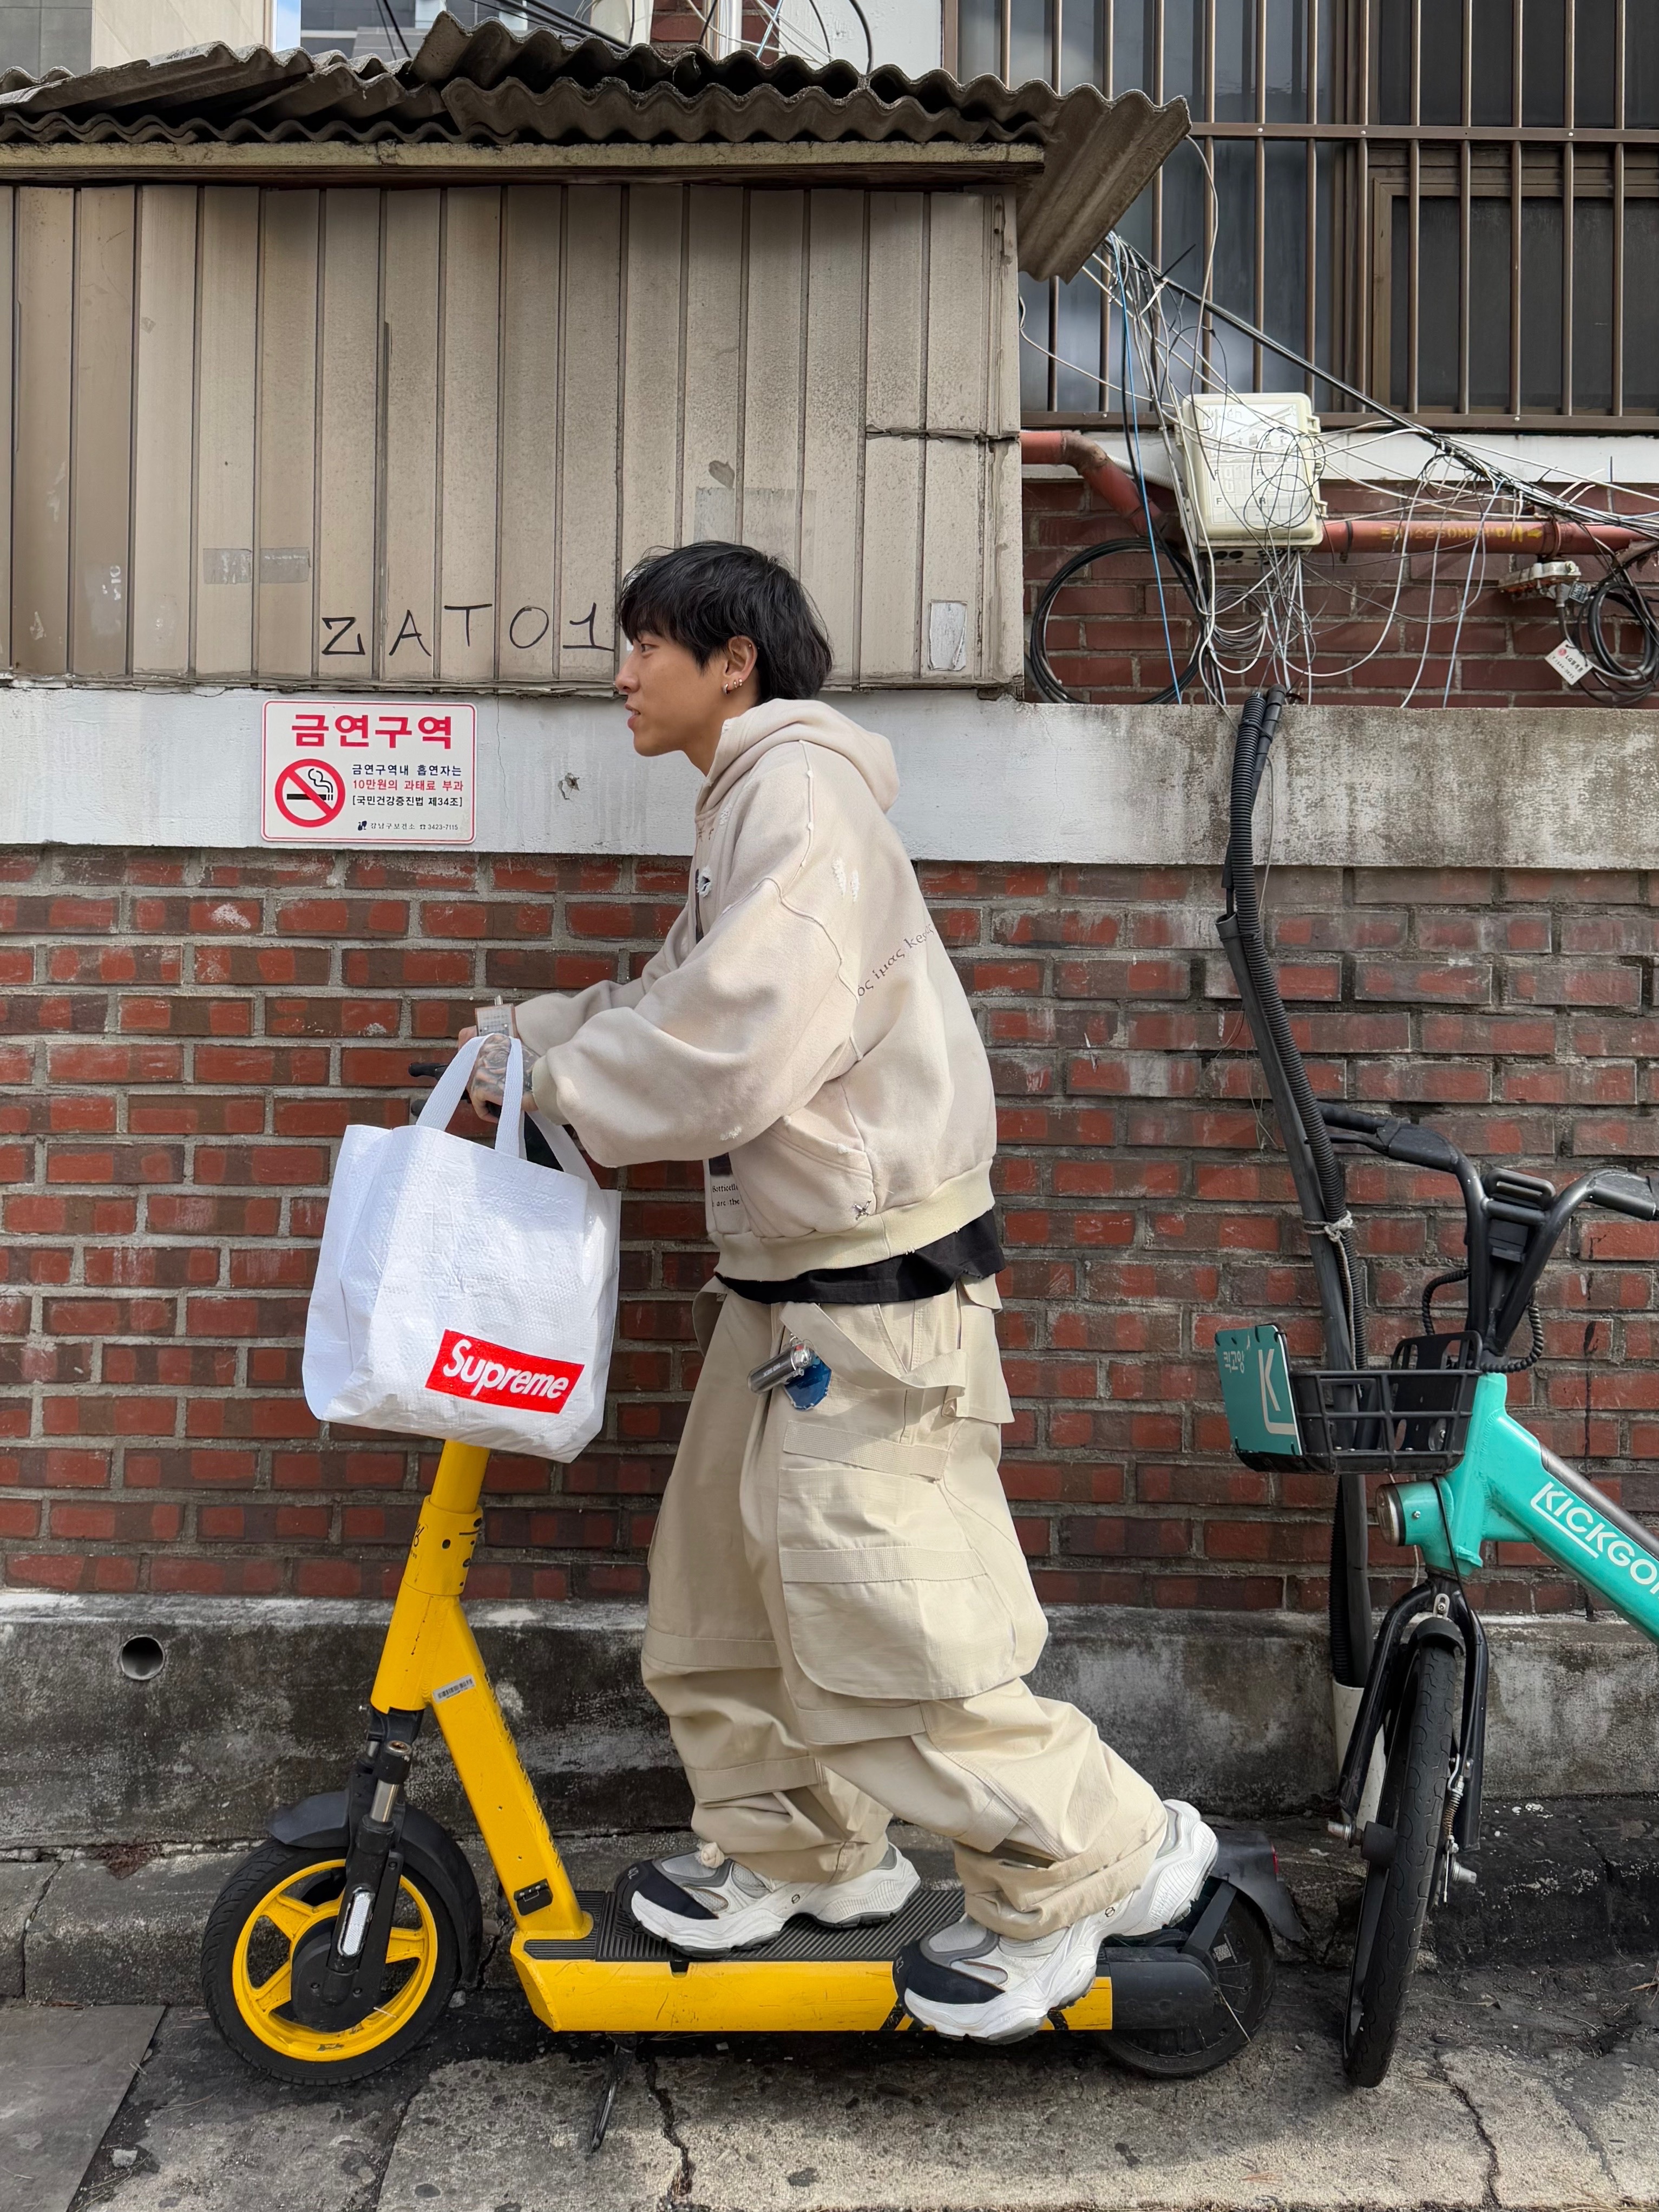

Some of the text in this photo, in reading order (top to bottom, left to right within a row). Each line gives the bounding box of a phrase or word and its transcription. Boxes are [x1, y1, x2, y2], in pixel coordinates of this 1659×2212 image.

[292, 715, 451, 749] 금연구역
[352, 764, 462, 776] 금연구역내 흡연자는
[353, 779, 463, 791] 10만원의 과태료 부과
[353, 795, 462, 807] [국민건강증진법 제34조]
[443, 1339, 569, 1399] Supreme
